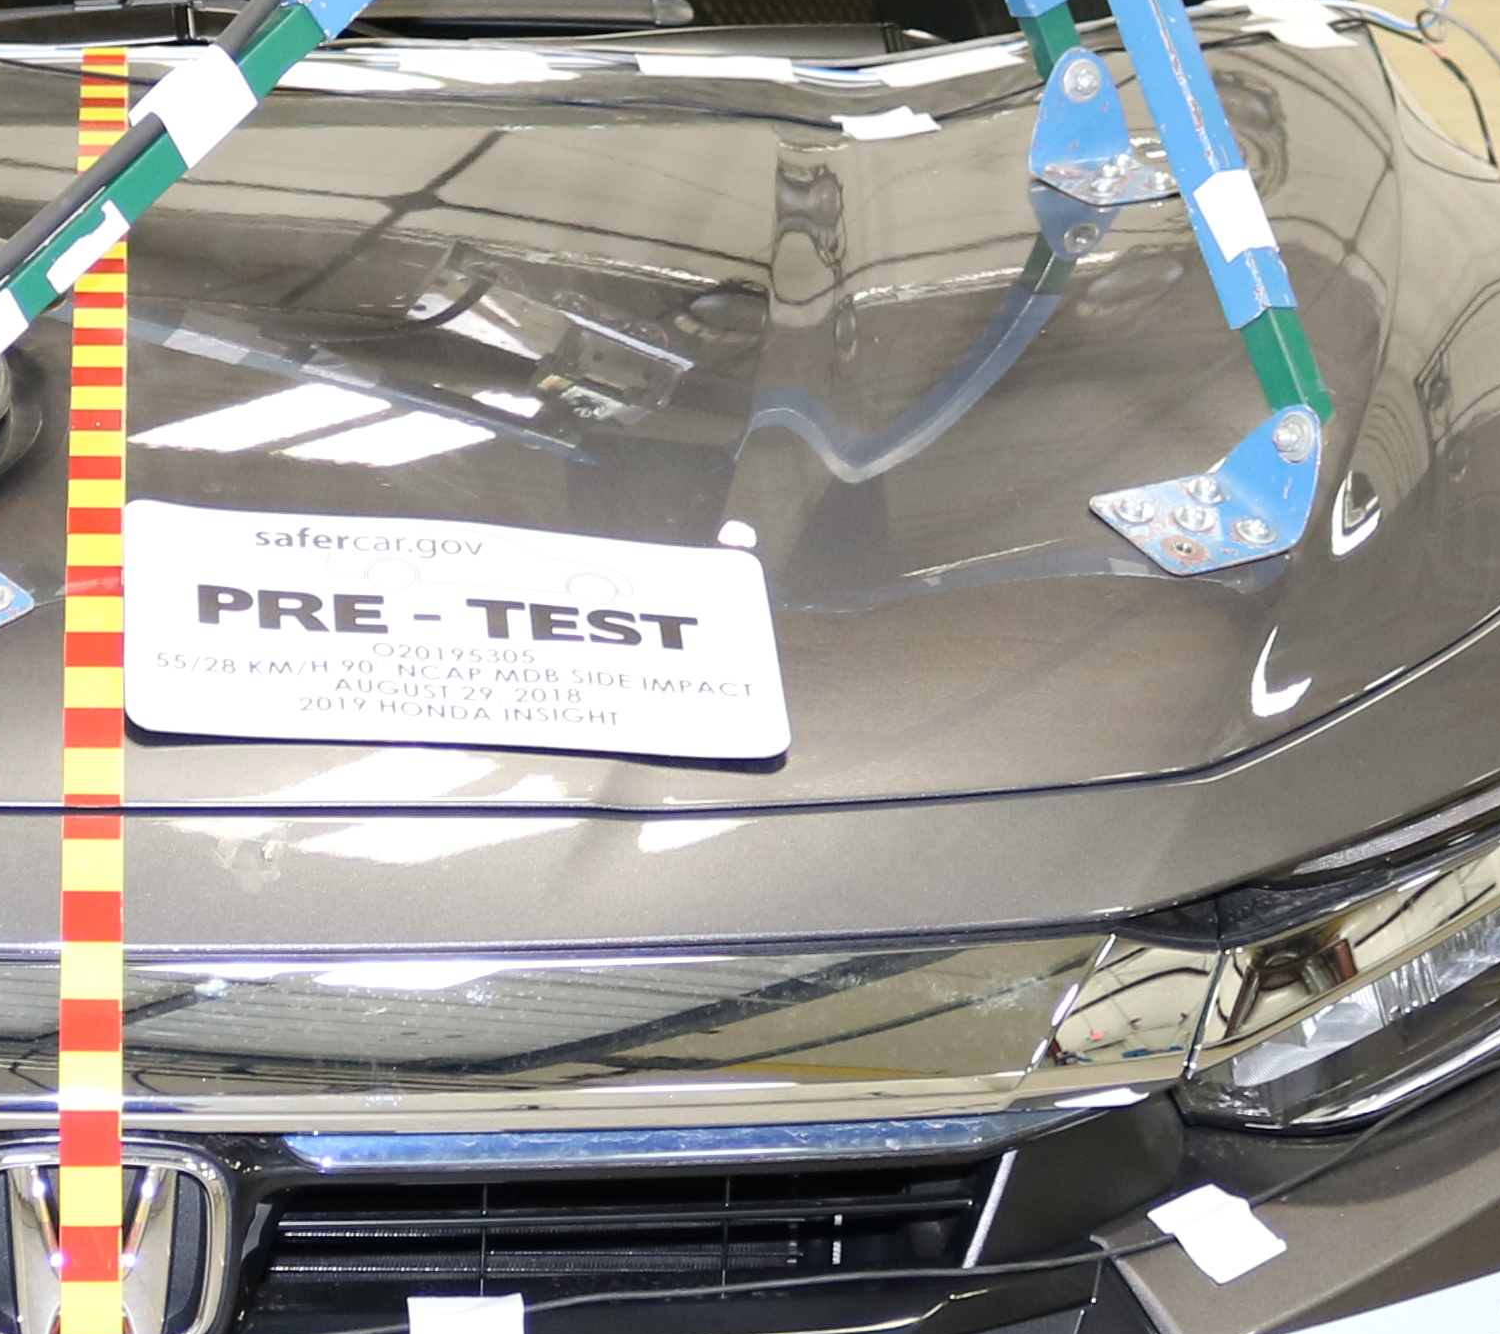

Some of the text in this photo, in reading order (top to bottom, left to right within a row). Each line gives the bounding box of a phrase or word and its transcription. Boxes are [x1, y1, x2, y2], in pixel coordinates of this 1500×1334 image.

[254, 526, 484, 559] safercar.gov
[197, 583, 389, 634] PRE
[465, 598, 699, 651] TEST
[156, 652, 237, 674] 55/28
[249, 659, 329, 676] KM/H
[397, 663, 482, 681] NCAP
[494, 668, 560, 683] MDB
[571, 669, 631, 689] SIDE
[642, 676, 752, 697] IMPACT
[334, 678, 449, 699] AUGUST
[514, 687, 582, 704] 2018
[299, 696, 619, 726] 2019 HONDA INSIGHT
